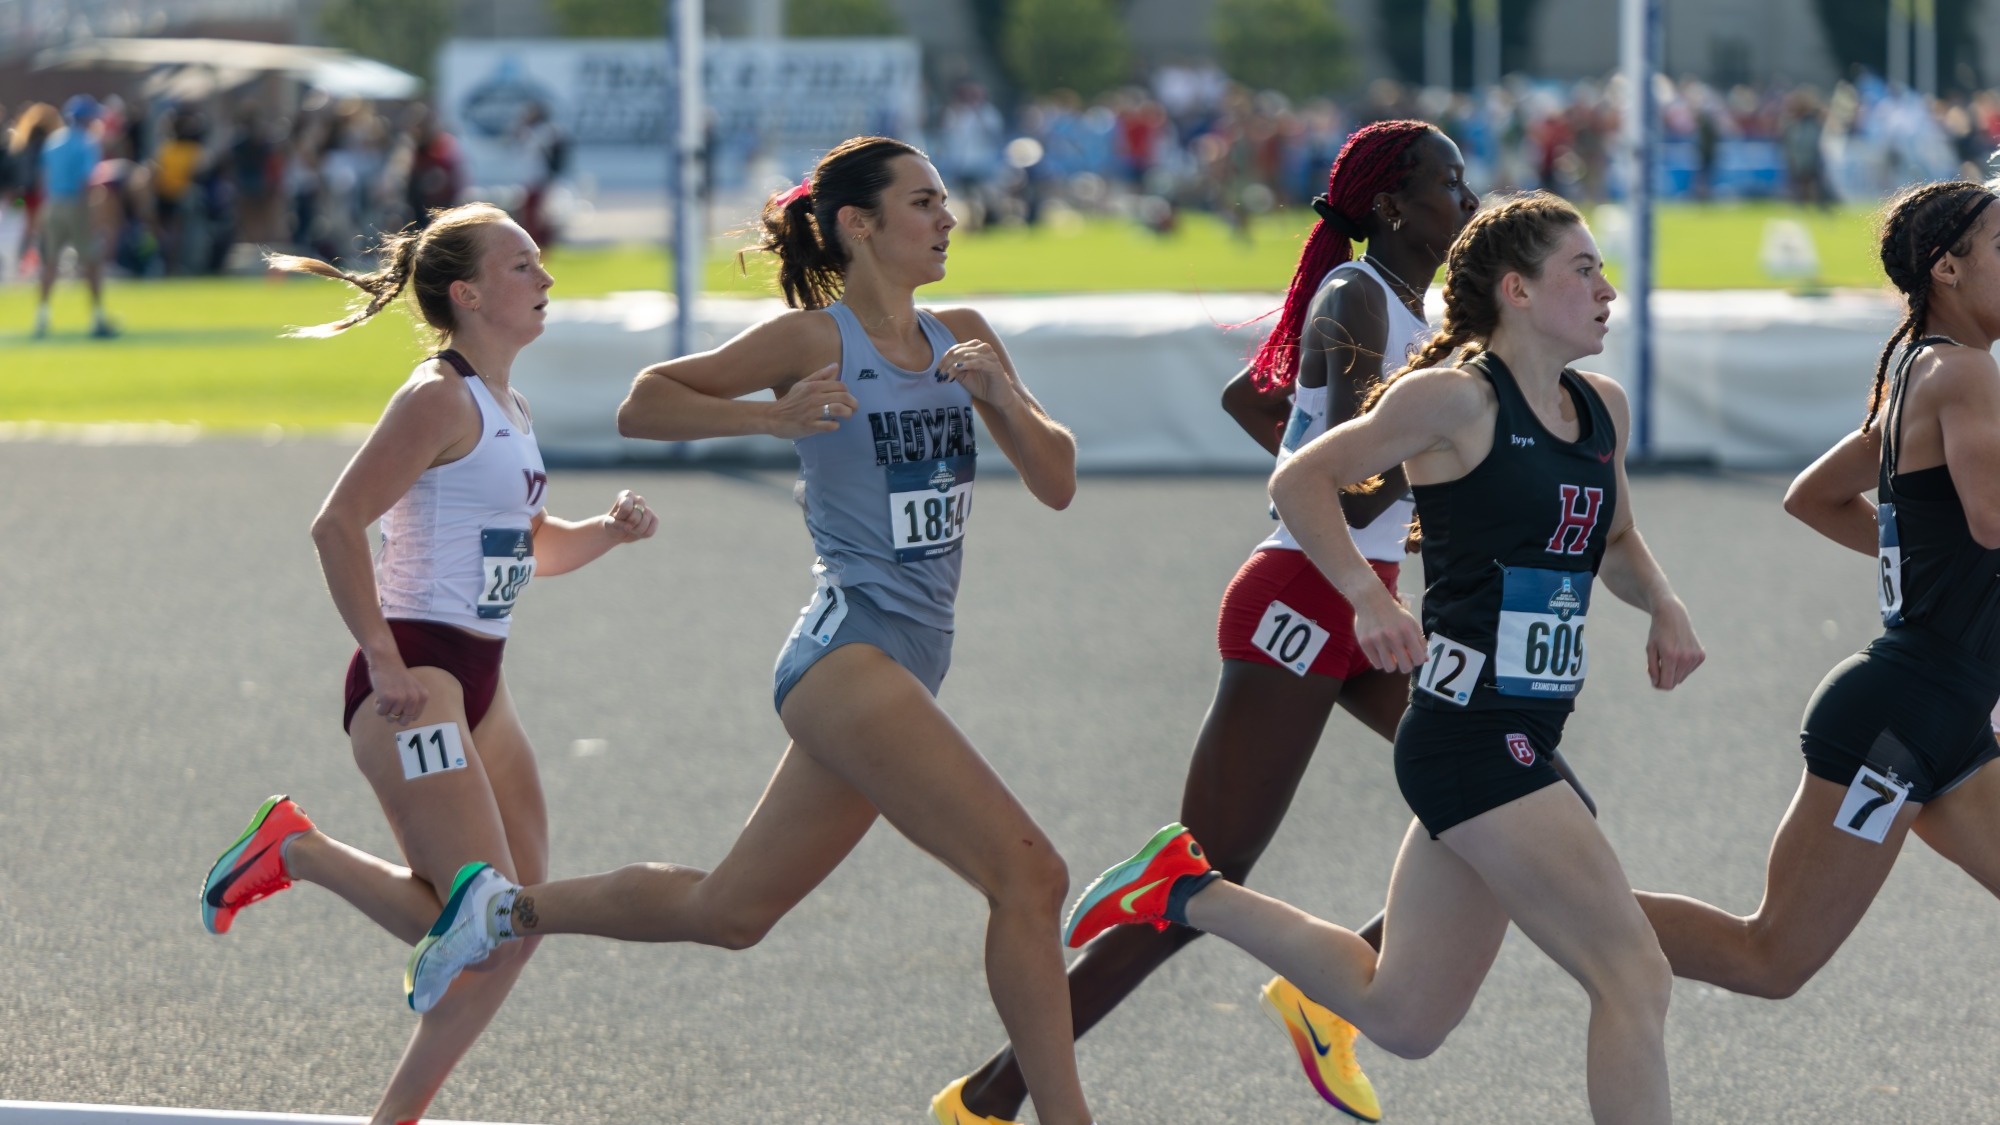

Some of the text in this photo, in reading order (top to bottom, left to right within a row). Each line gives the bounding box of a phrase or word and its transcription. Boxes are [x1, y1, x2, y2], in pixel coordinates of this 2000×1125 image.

[1511, 434, 1527, 447] Ivy
[522, 468, 548, 506] VT
[904, 491, 965, 543] 1854
[1545, 484, 1603, 554] H
[1266, 613, 1311, 663] 10
[1525, 621, 1584, 676] 609
[1427, 643, 1467, 698] 12
[408, 728, 449, 773] 11
[1513, 742, 1532, 759] H
[1847, 773, 1898, 831] 7
